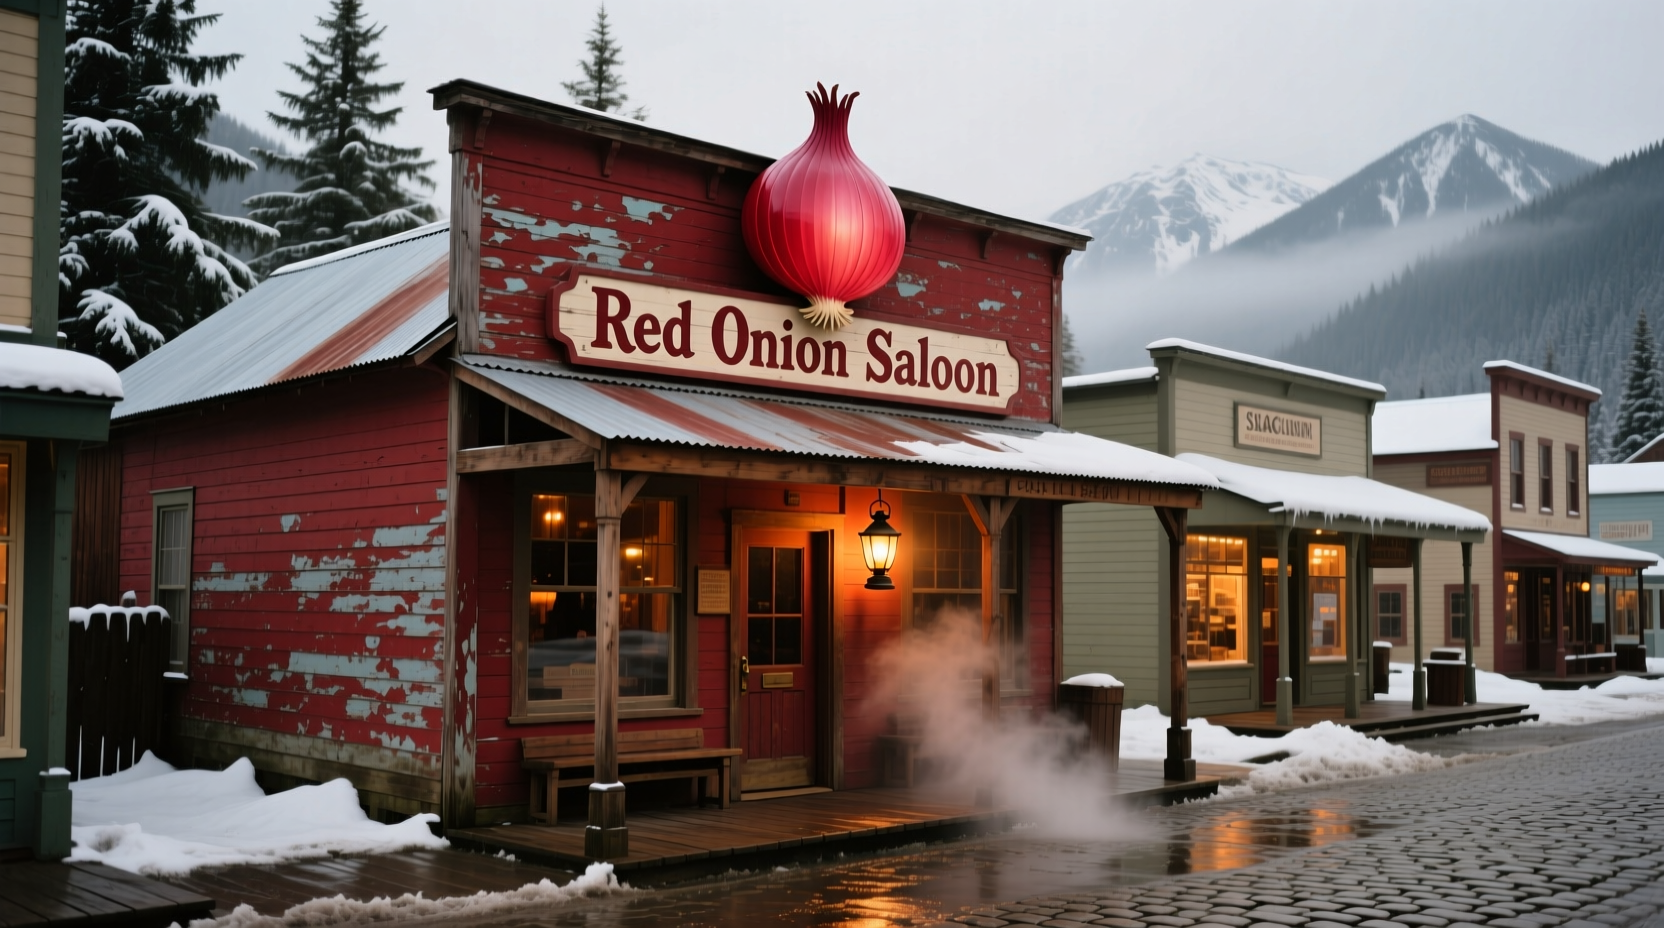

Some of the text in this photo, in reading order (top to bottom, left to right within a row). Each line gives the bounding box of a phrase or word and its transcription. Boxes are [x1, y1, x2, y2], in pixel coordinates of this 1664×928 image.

[591, 286, 999, 397] Red Onion Saloon
